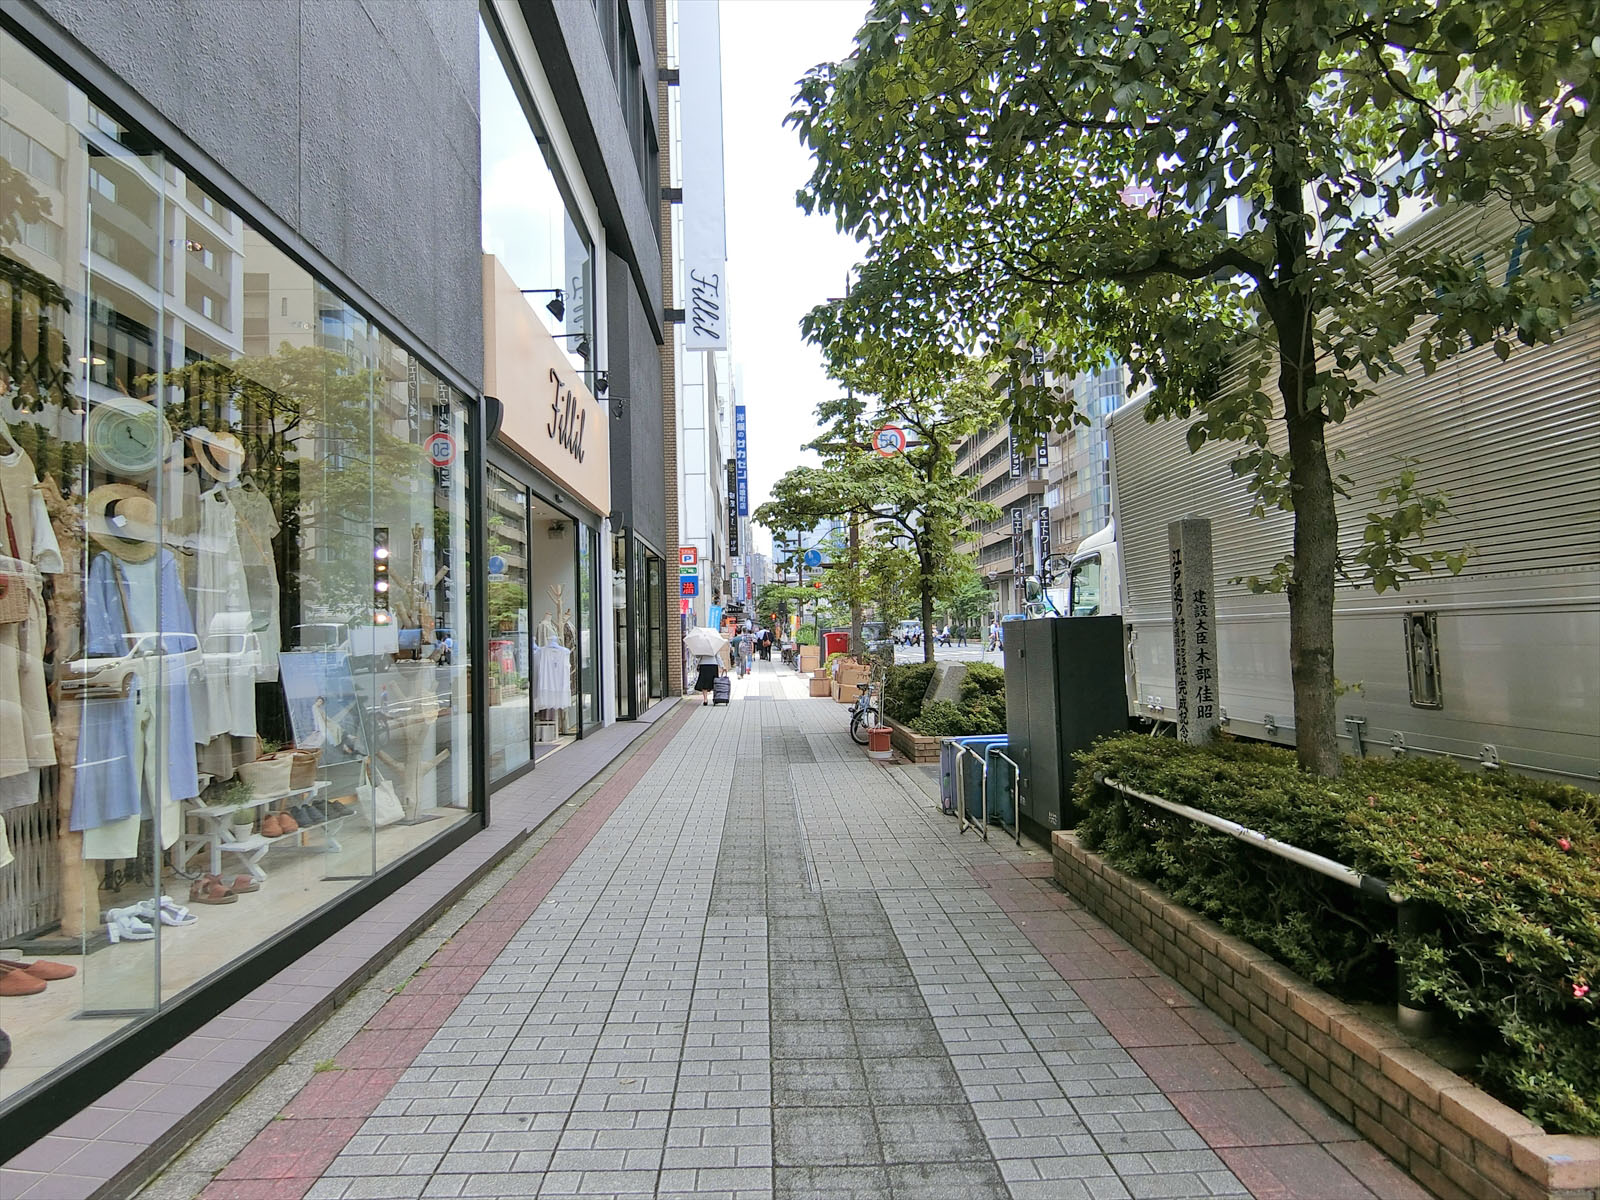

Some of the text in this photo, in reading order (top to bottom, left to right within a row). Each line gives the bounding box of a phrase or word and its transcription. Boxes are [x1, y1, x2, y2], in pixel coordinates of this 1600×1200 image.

[690, 268, 721, 341] Fillil
[547, 367, 586, 464] Fillil
[879, 434, 899, 448] 50
[1172, 549, 1184, 616] 江戸通り
[1176, 678, 1191, 744] 完成記念
